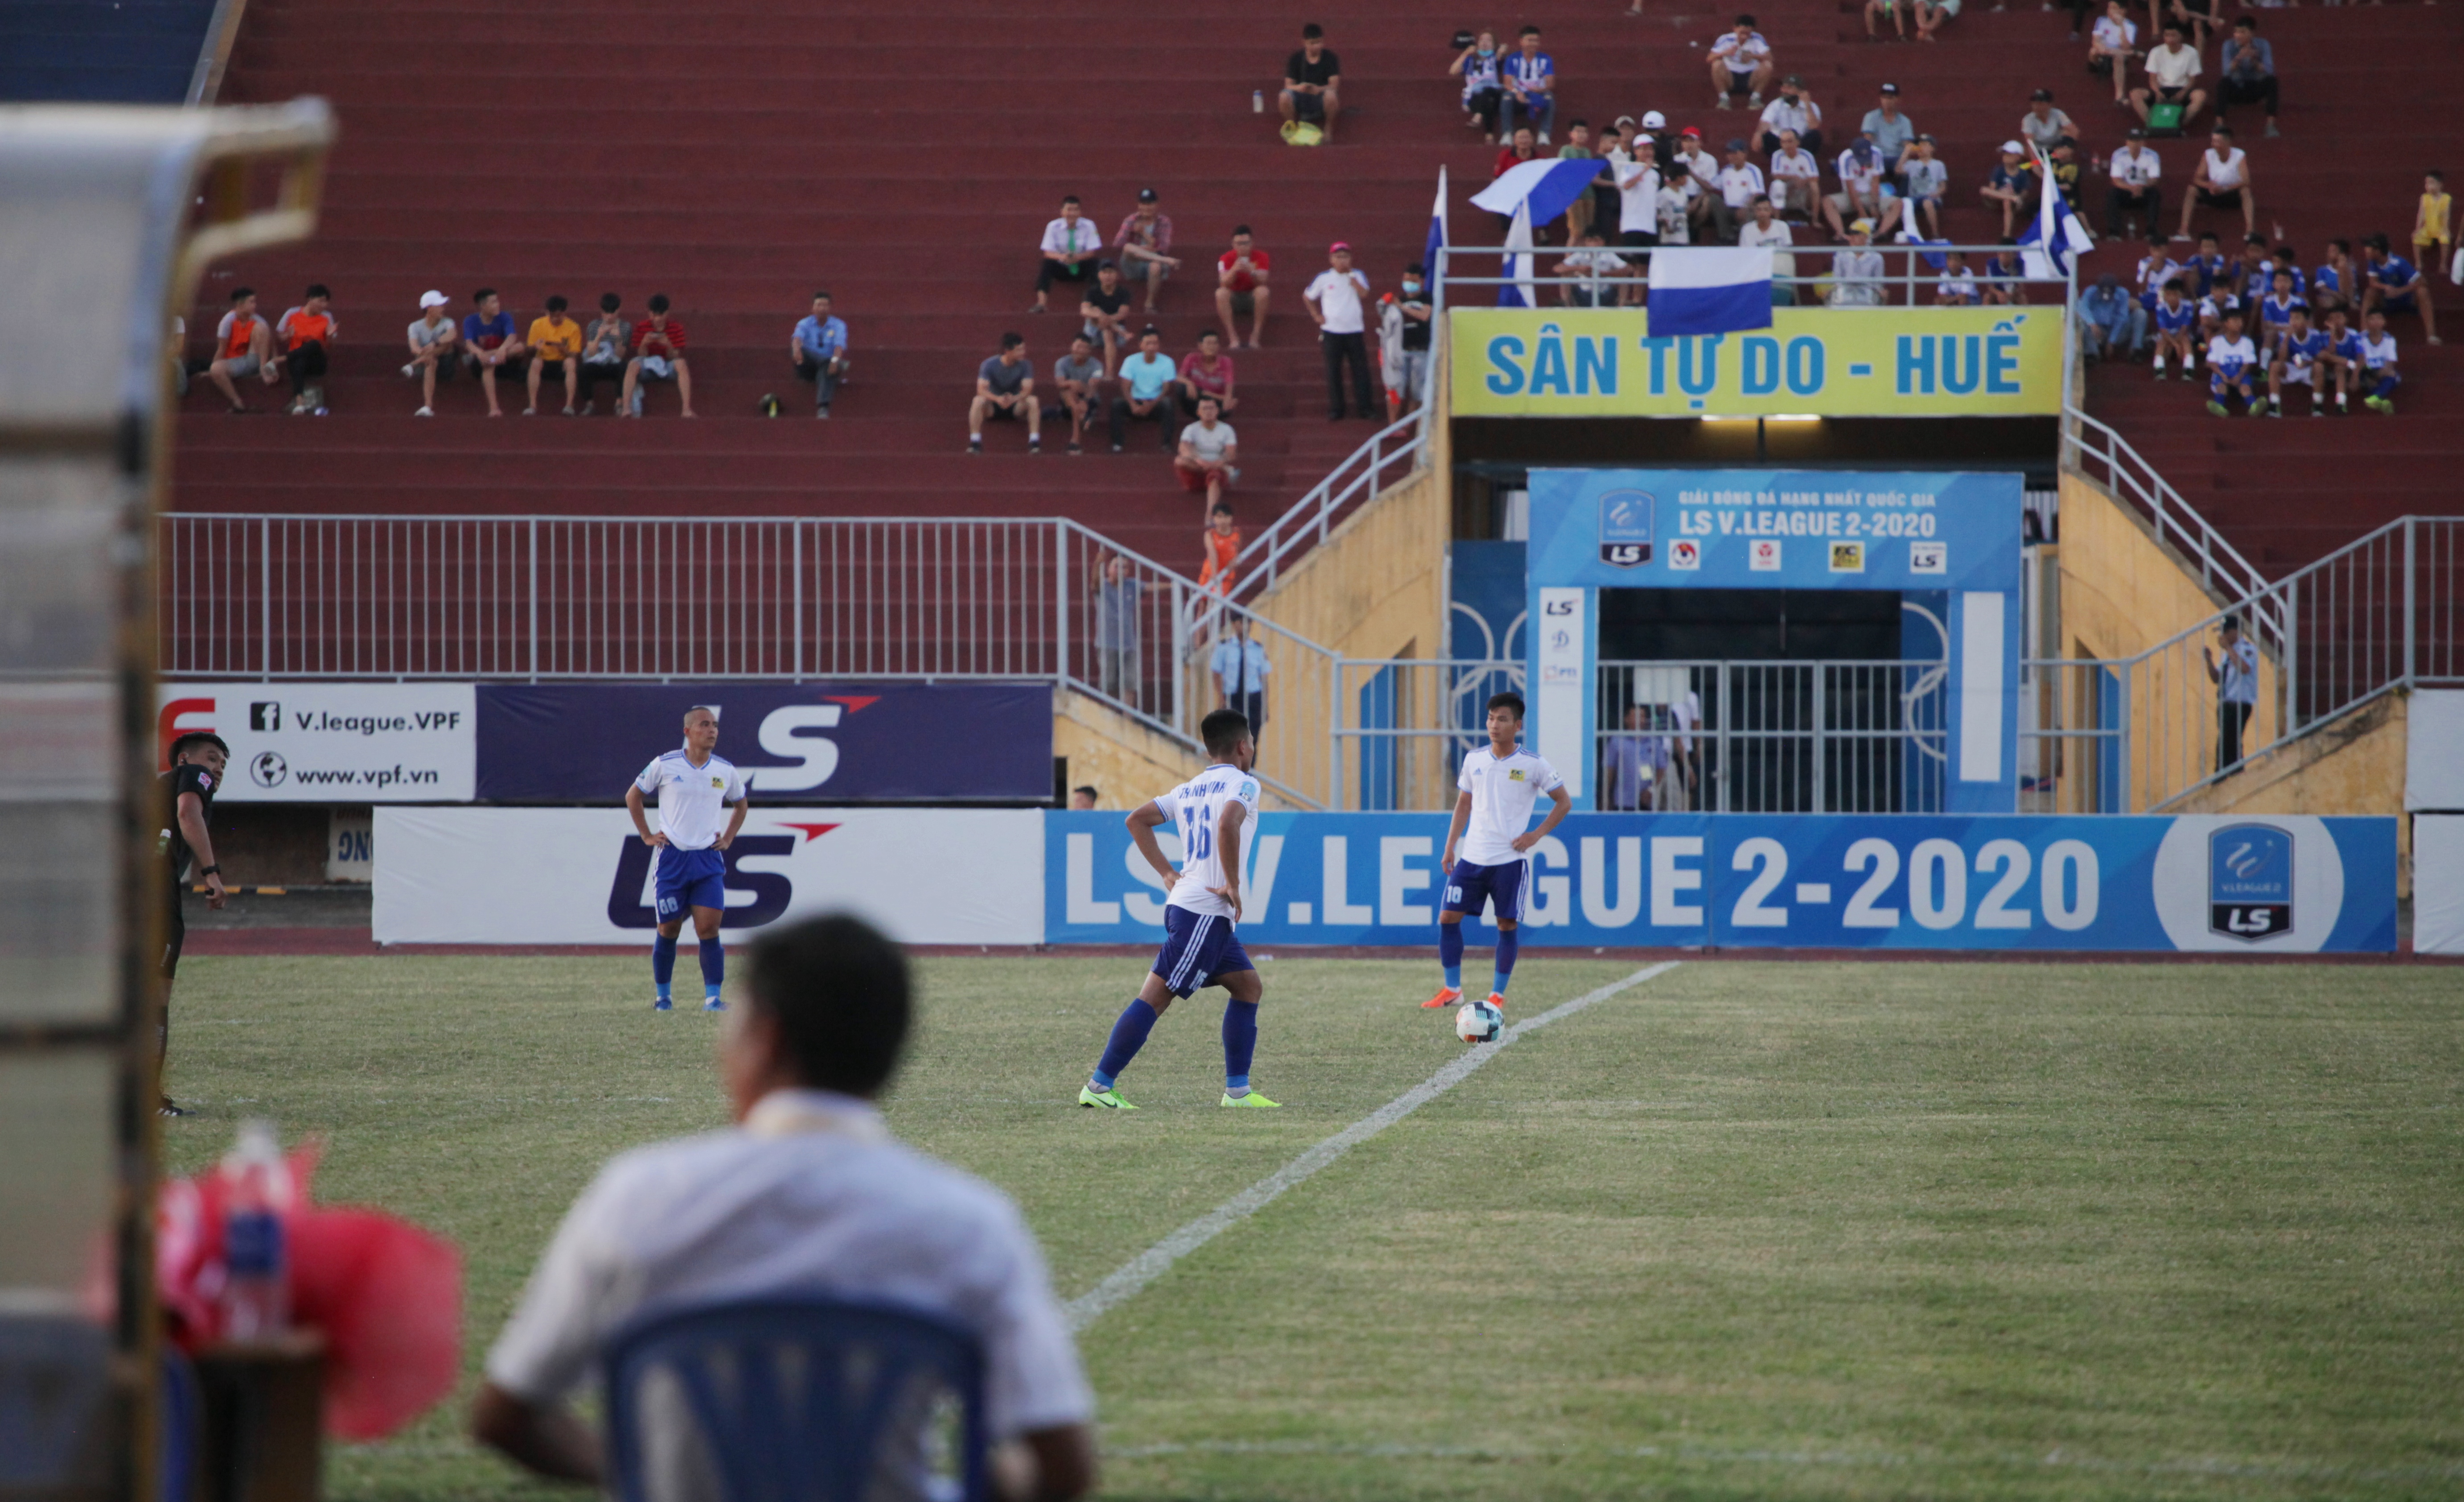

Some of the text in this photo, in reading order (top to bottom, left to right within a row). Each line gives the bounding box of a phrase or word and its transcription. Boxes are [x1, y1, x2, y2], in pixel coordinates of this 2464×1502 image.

[1486, 314, 2026, 409] SÂN TỰ DO - HUẾ
[1911, 493, 1936, 507] GIA
[1680, 510, 1936, 537] LS V.LEAGUE 2-2020
[1610, 546, 1640, 563] LS
[1913, 554, 1937, 567] LS
[1546, 600, 1573, 616] LS
[296, 712, 460, 735] V.league.VPF
[296, 765, 439, 788] www.vpf.vn
[1183, 804, 1211, 862] 16
[1237, 834, 1704, 927] V.LEGUE
[1731, 837, 2099, 930] 2-2020
[2229, 908, 2271, 932] LS
